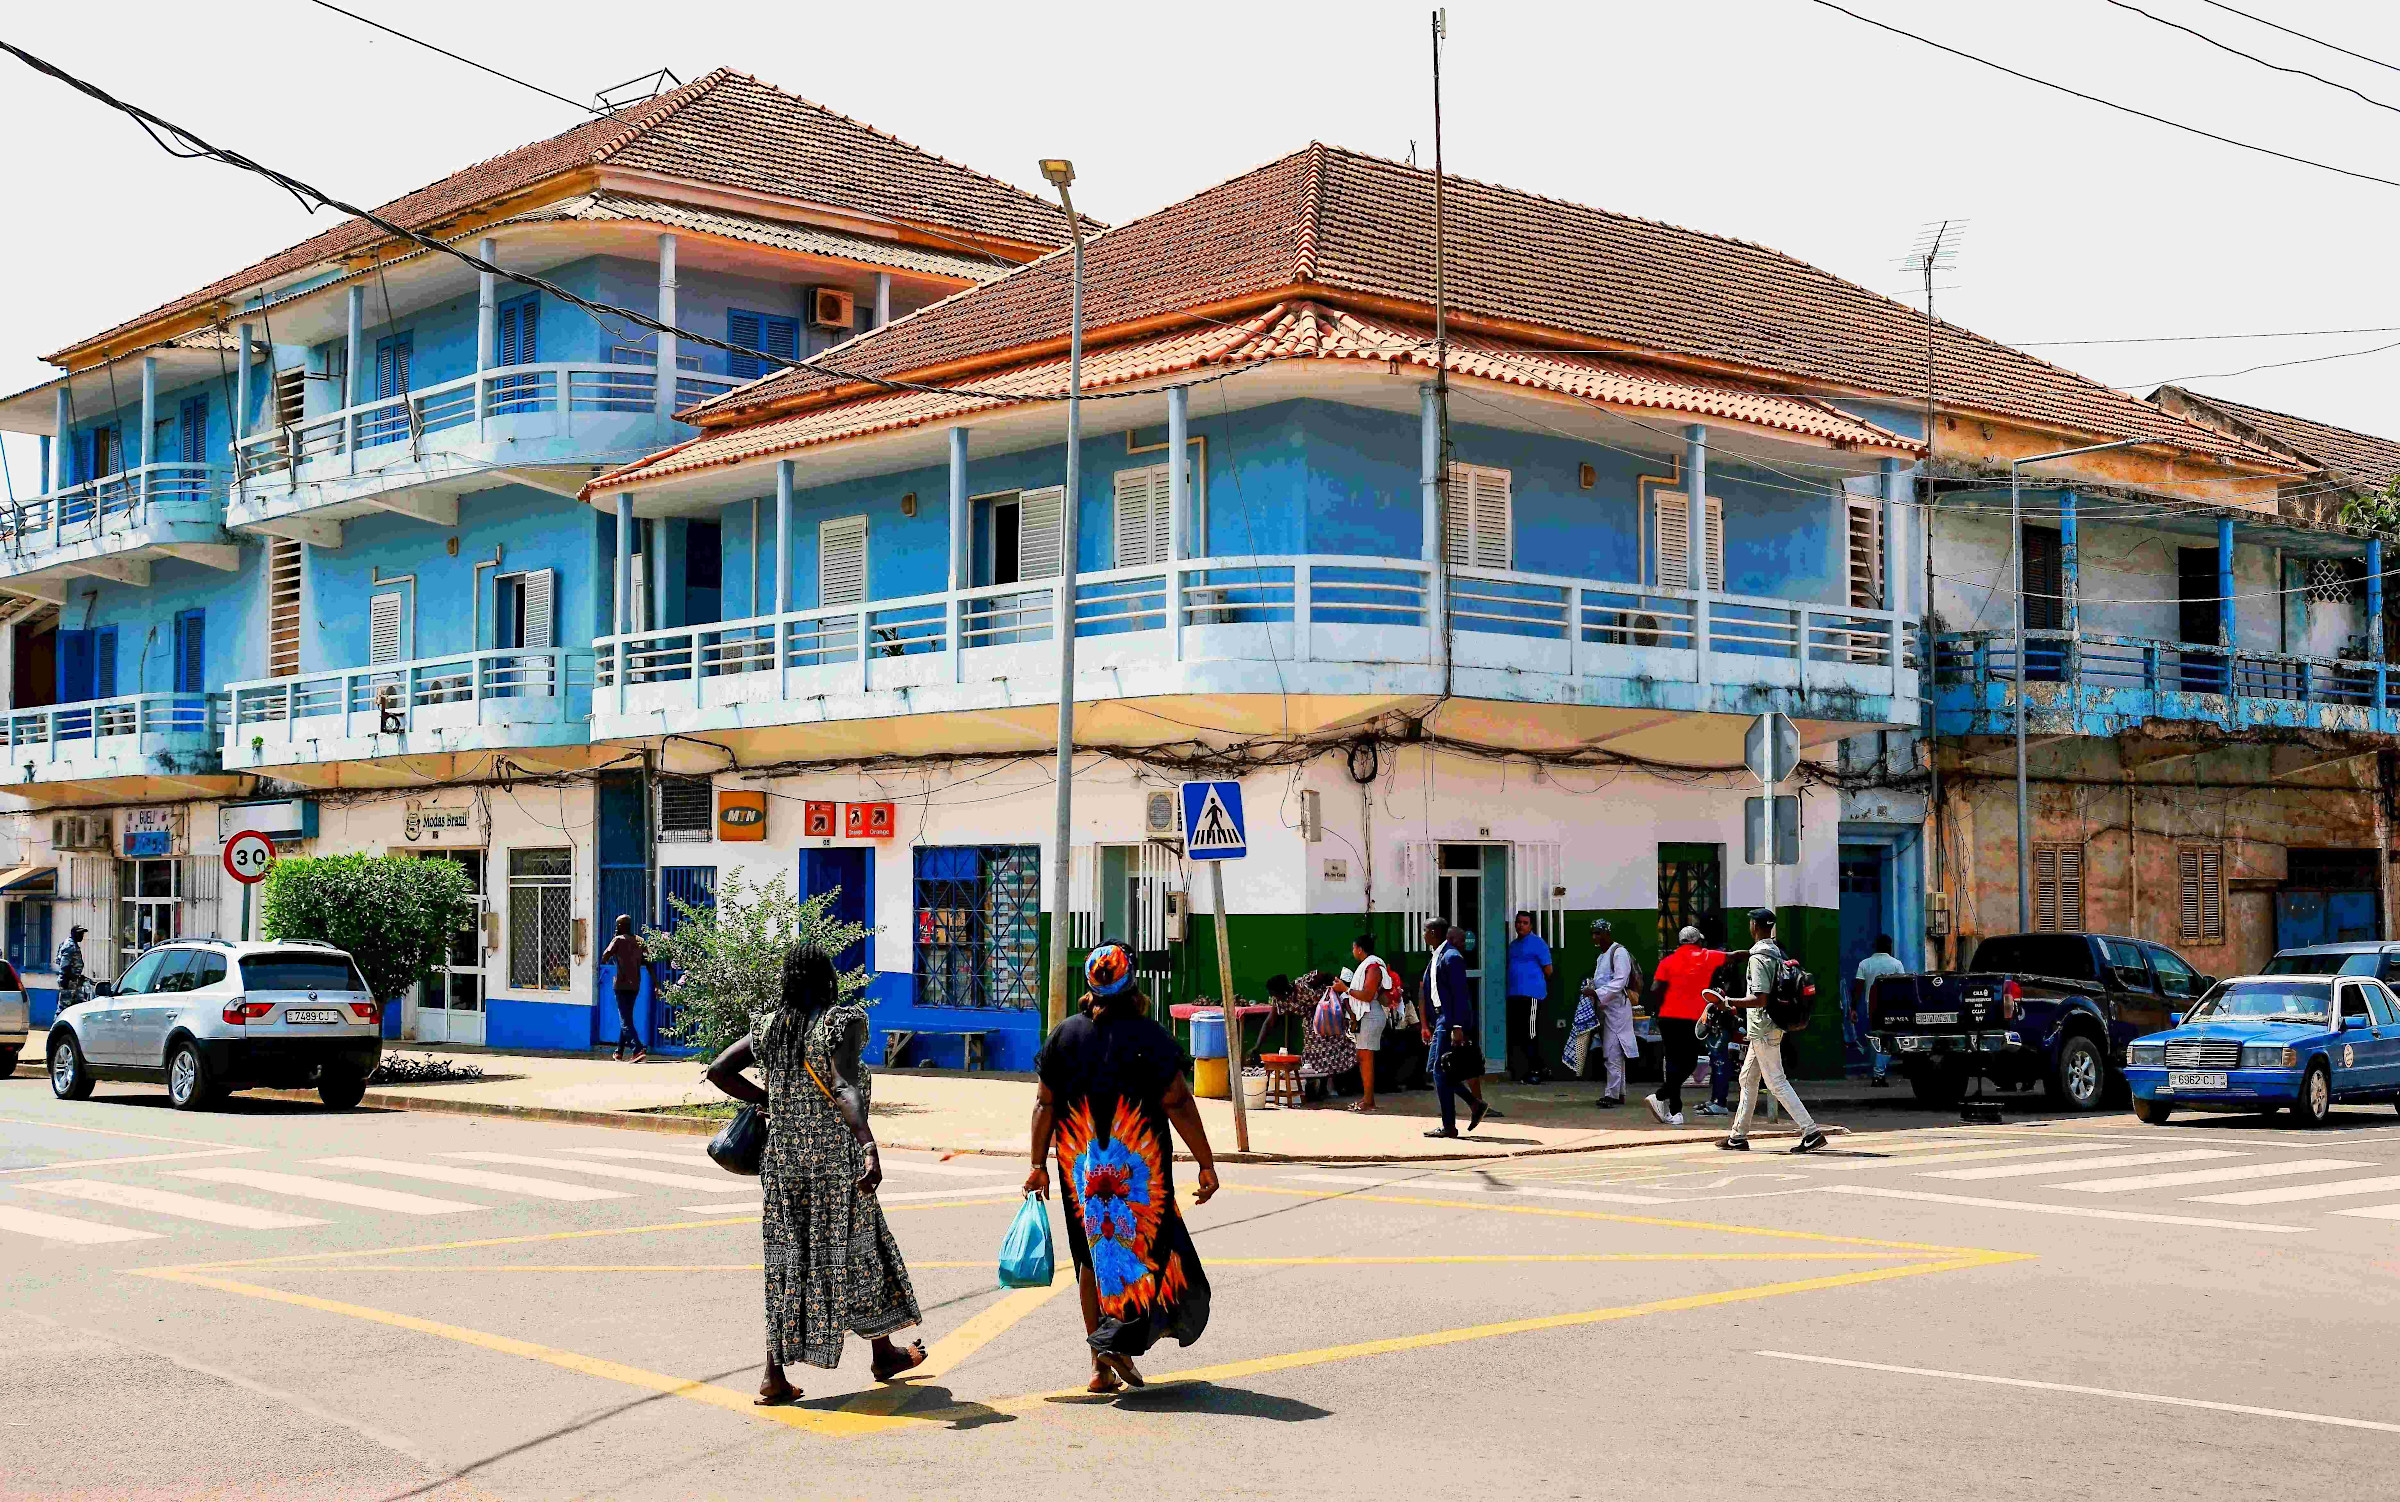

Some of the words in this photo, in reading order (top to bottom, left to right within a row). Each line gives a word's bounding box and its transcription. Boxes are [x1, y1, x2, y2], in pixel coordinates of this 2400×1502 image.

[423, 813, 446, 828] Modas
[727, 810, 756, 822] MTN
[869, 828, 890, 836] Orange
[1480, 828, 1489, 836] 01
[236, 848, 266, 866] 30
